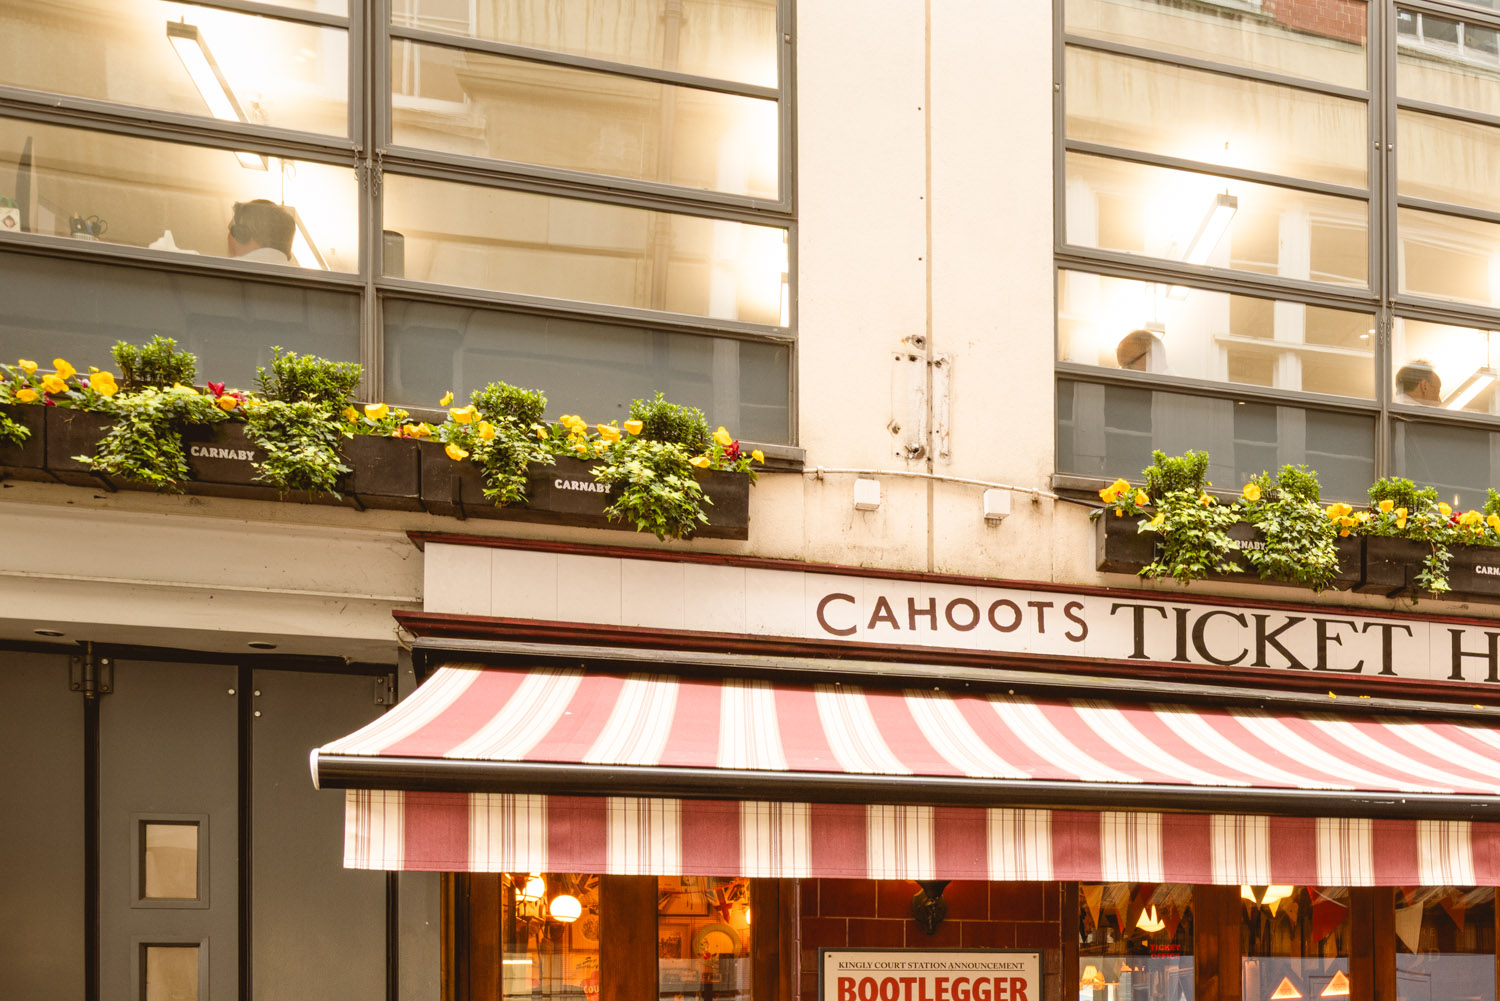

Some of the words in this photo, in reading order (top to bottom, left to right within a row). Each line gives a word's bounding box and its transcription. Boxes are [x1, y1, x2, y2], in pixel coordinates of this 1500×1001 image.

[190, 446, 255, 461] CARNABY
[554, 479, 612, 494] CARNABY
[816, 592, 1089, 643] CAHOOTS
[1110, 602, 1413, 676] TICKET
[838, 962, 873, 970] KINGLY
[874, 962, 906, 970] COURT
[907, 961, 947, 970] STATION
[948, 961, 1025, 970] ANNOUNCEMENT
